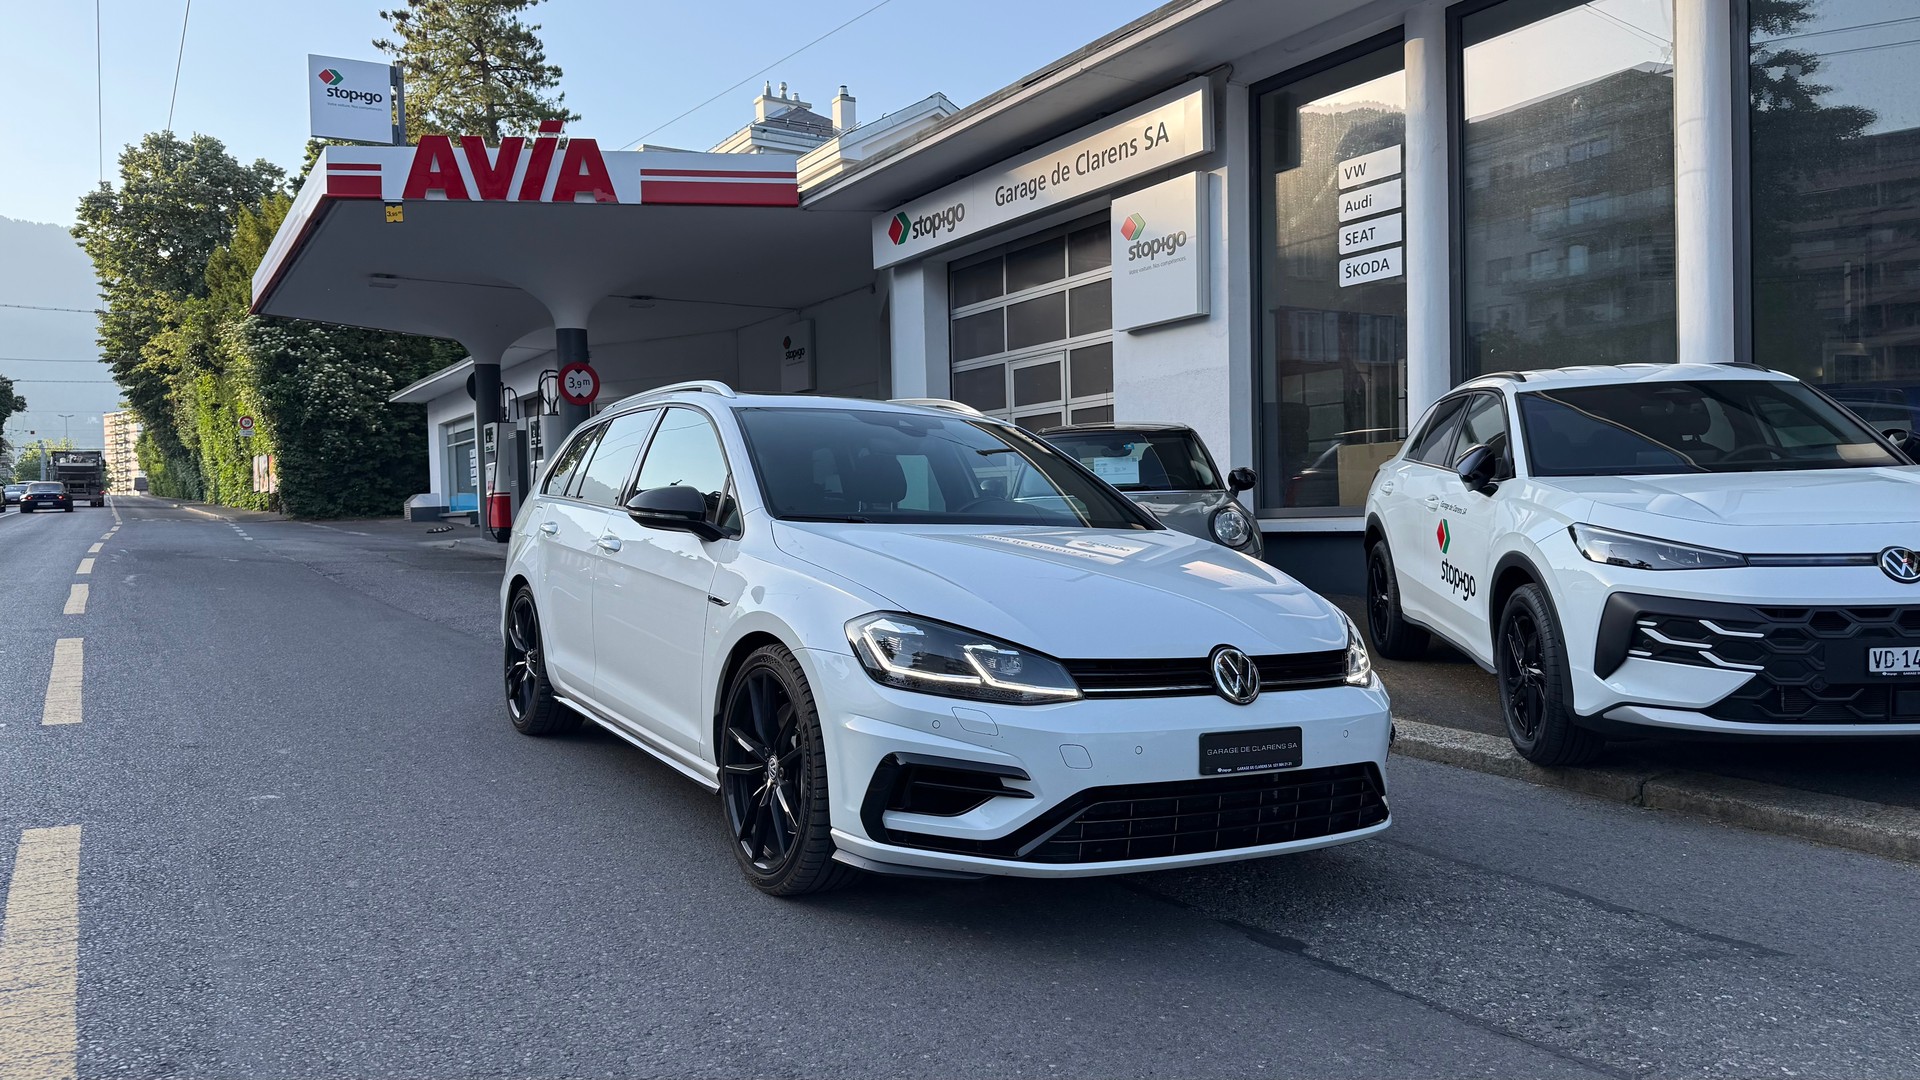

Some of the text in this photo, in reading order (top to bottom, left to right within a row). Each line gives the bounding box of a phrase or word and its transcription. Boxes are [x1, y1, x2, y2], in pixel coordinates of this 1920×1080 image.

[327, 86, 383, 105] stop+go
[995, 121, 1170, 206] Garage de Clarens SA
[1344, 162, 1367, 180] VW
[1344, 194, 1372, 213] Audi
[912, 201, 965, 240] stop+go
[1128, 230, 1187, 261] stop+go
[1345, 227, 1376, 246] SEAT
[1345, 257, 1390, 279] ŠKODA
[1441, 558, 1476, 601] stop+go
[1207, 747, 1238, 756] GARAGE
[1251, 743, 1286, 752] CLARENS
